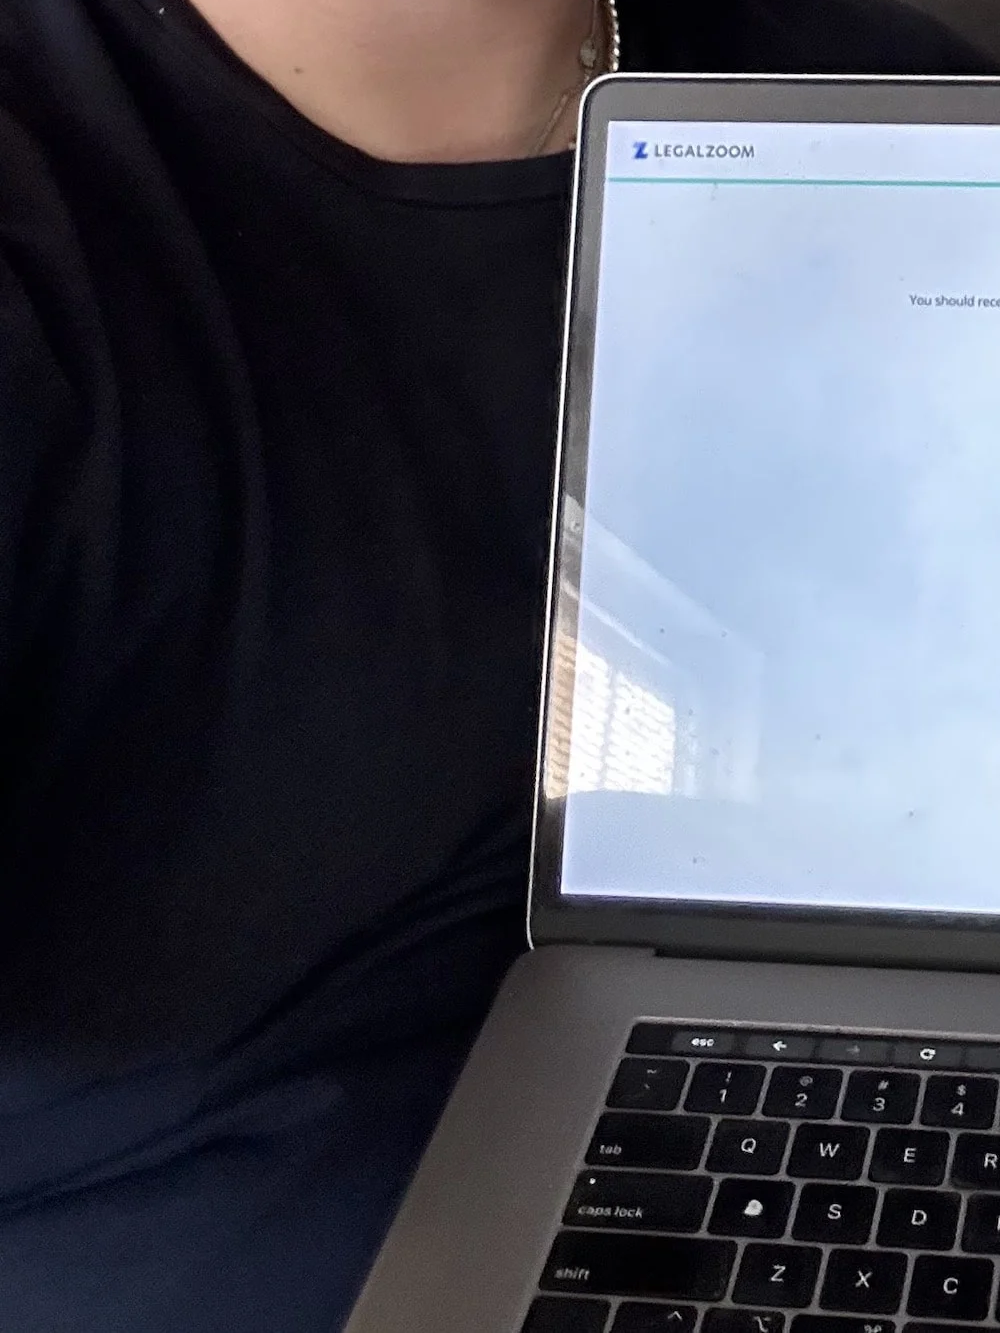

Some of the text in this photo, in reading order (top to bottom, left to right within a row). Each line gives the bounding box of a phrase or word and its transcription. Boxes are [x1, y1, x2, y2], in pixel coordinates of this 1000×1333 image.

[654, 144, 755, 158] LEGALZOOM
[909, 294, 932, 306] You
[935, 294, 975, 307] should
[691, 1037, 715, 1047] esc
[719, 1089, 727, 1103] 1
[794, 1093, 808, 1107] 2
[872, 1097, 886, 1112] 3
[951, 1102, 964, 1116] 4
[599, 1144, 622, 1155] tab
[740, 1138, 757, 1154] Q
[819, 1142, 840, 1158] W
[903, 1147, 916, 1163] E
[983, 1152, 998, 1169] R
[614, 1206, 643, 1218] lock
[827, 1203, 842, 1220] S
[911, 1209, 927, 1226] D
[555, 1267, 590, 1281] shift
[770, 1264, 786, 1282] Z
[855, 1270, 872, 1288] X
[943, 1277, 959, 1295] C
